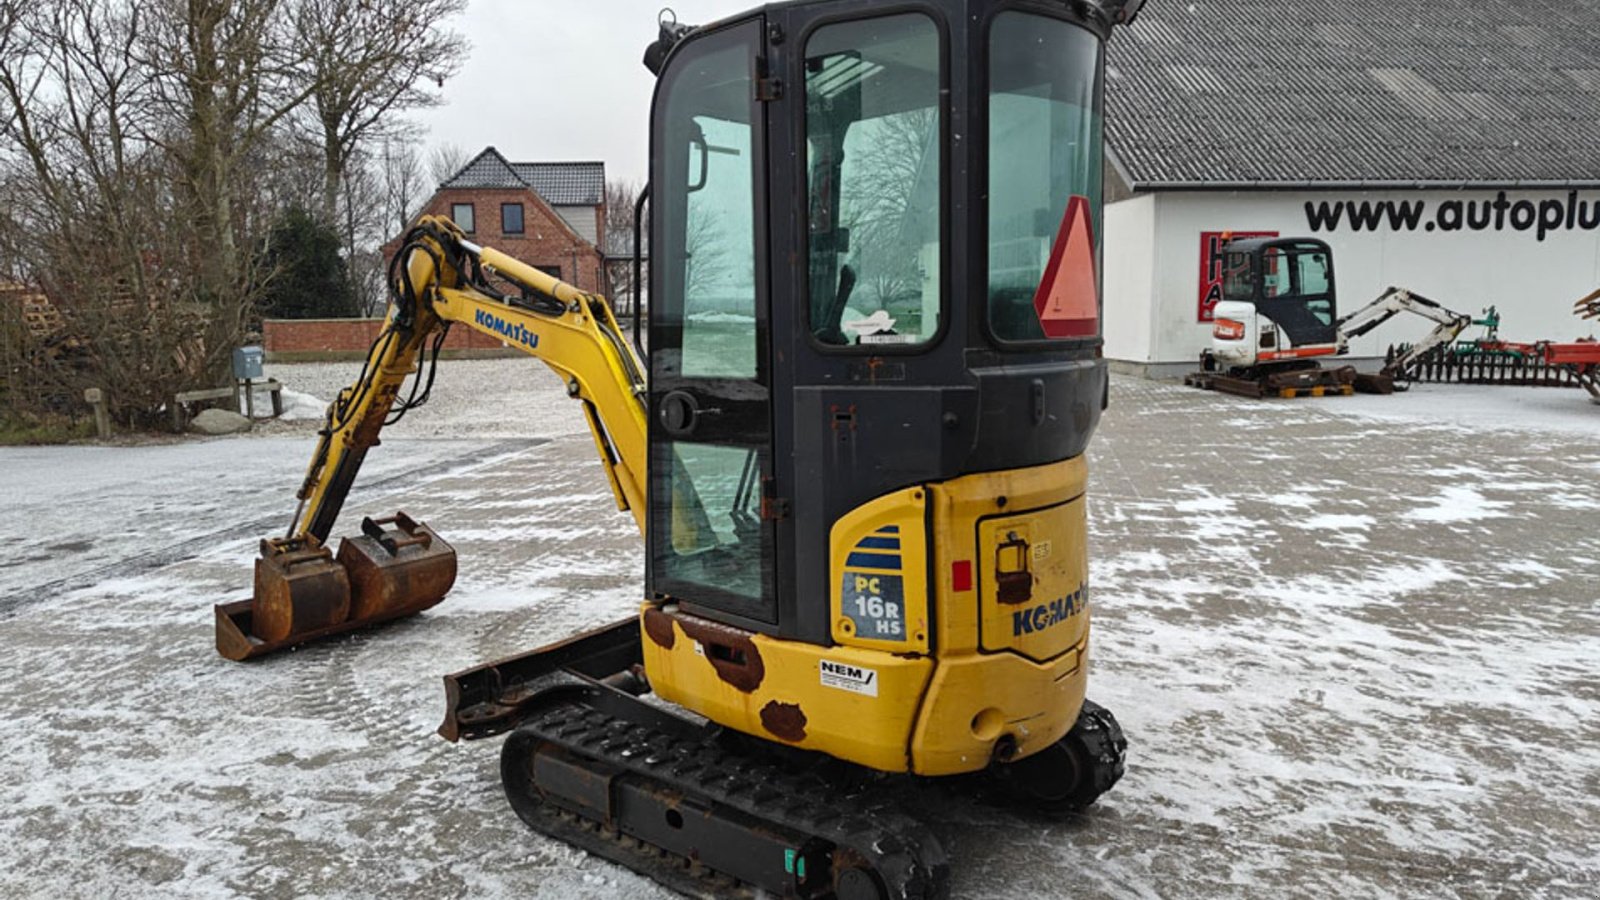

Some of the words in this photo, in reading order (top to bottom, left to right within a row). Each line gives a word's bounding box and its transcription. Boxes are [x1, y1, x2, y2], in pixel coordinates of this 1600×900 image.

[1304, 190, 1600, 242] www.autoplu
[475, 308, 539, 349] KOMATSU
[855, 576, 880, 595] PC
[855, 595, 899, 619] 16R
[876, 620, 901, 635] HS
